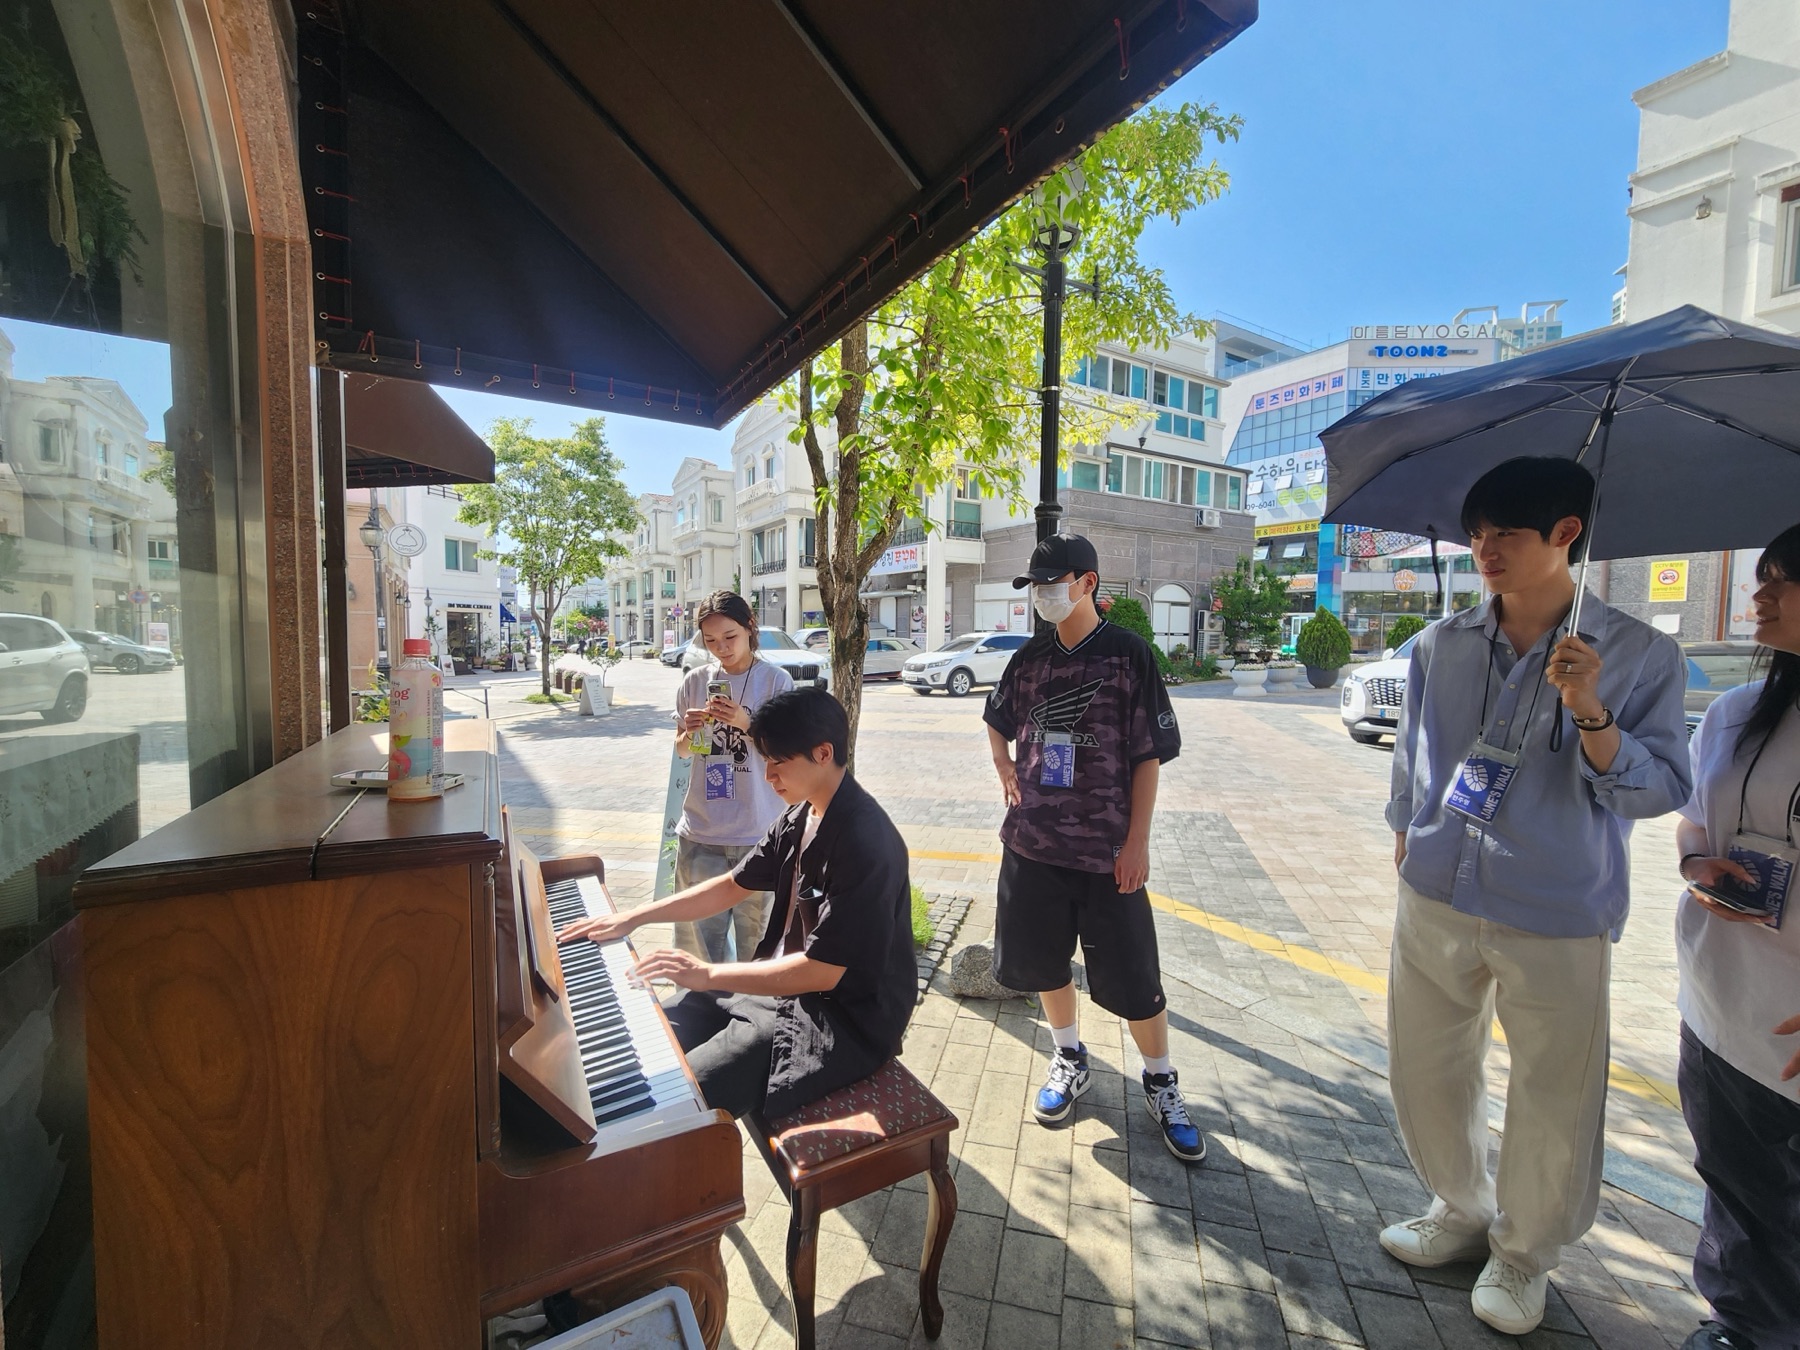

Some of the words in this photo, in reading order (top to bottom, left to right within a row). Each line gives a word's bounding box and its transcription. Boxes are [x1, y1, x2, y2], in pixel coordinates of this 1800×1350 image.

[1417, 324, 1488, 339] YOGA
[1374, 344, 1449, 358] TOONZ
[1029, 730, 1100, 748] HDA
[1063, 745, 1073, 764] WALK
[1480, 790, 1502, 820] JANE'S
[1492, 765, 1514, 791] WALK
[1769, 859, 1790, 891] WALK
